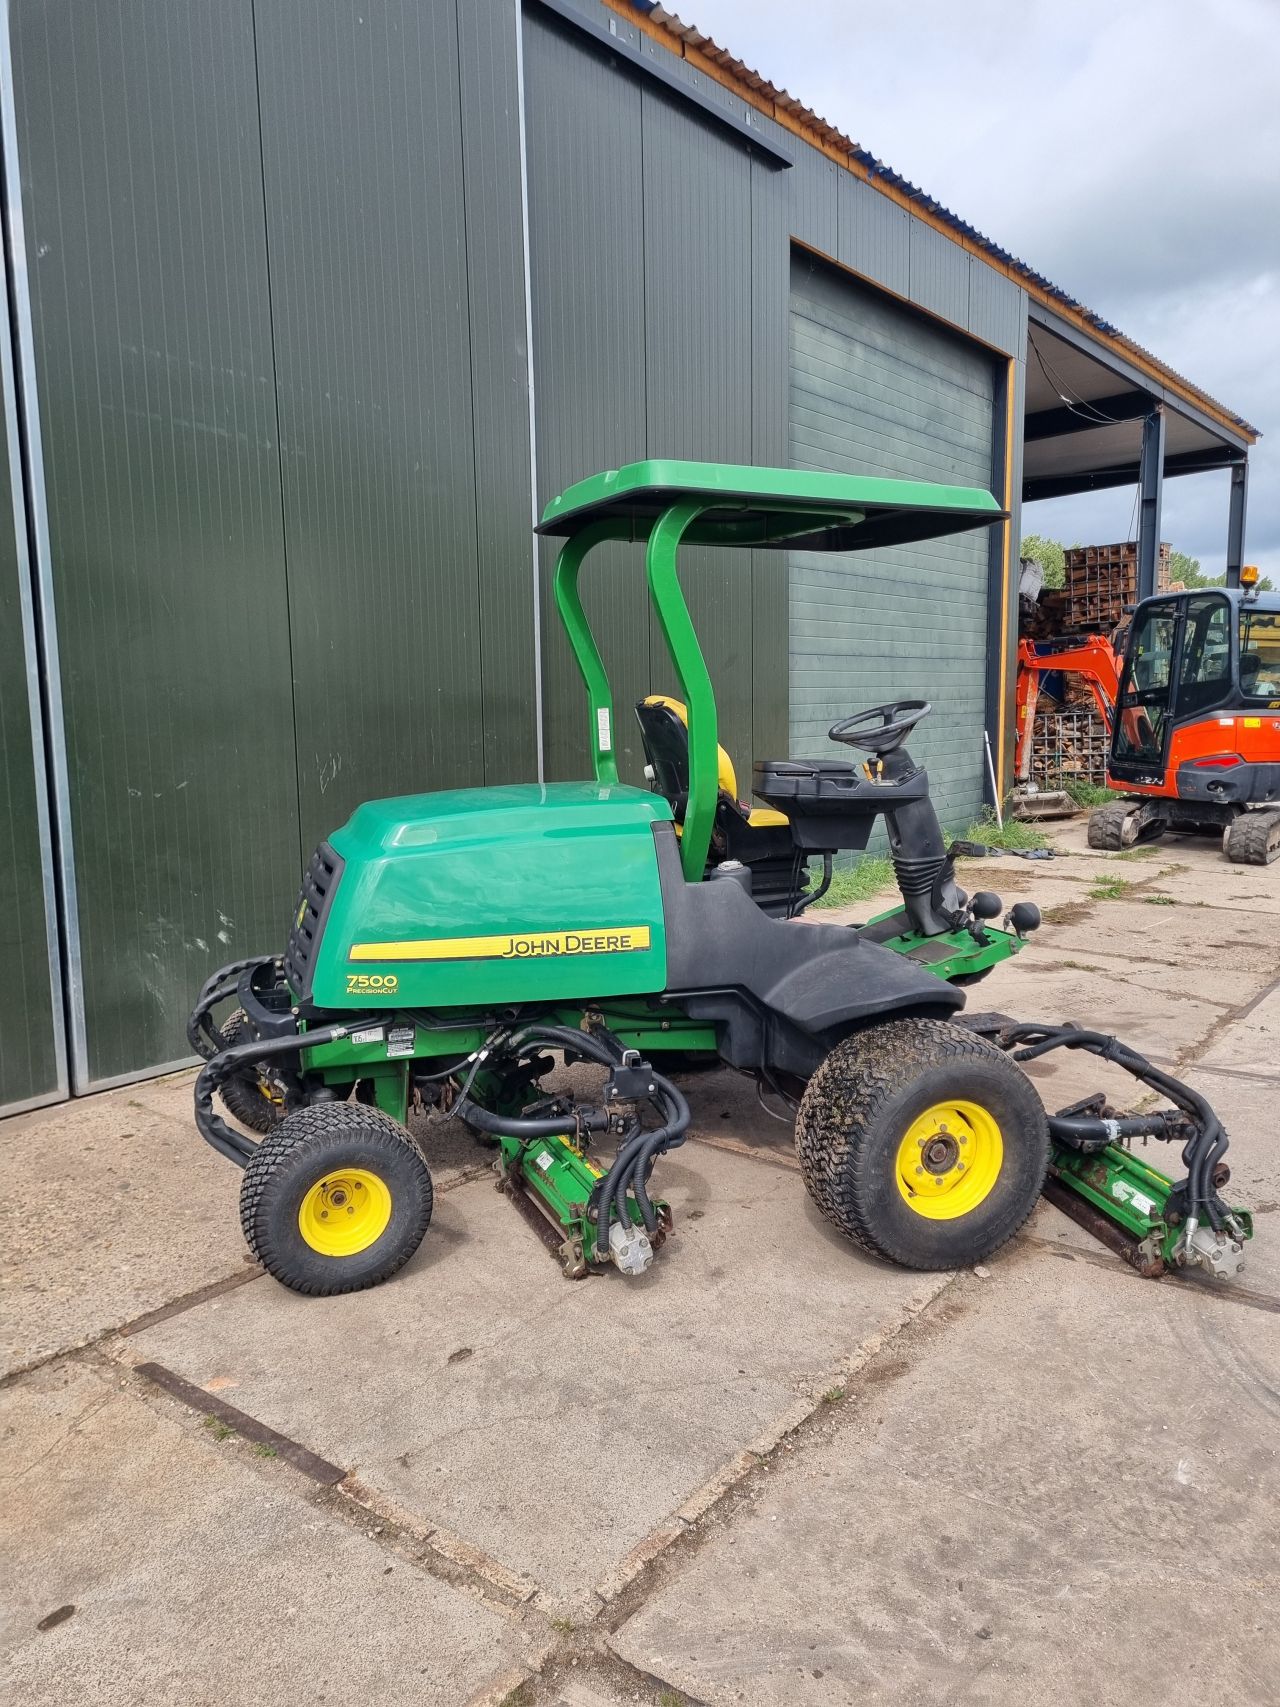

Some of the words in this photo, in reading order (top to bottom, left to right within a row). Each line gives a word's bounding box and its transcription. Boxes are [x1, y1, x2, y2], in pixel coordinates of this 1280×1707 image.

[502, 938, 560, 955] JOHN
[565, 935, 632, 952] DEERE
[346, 974, 398, 987] 7500
